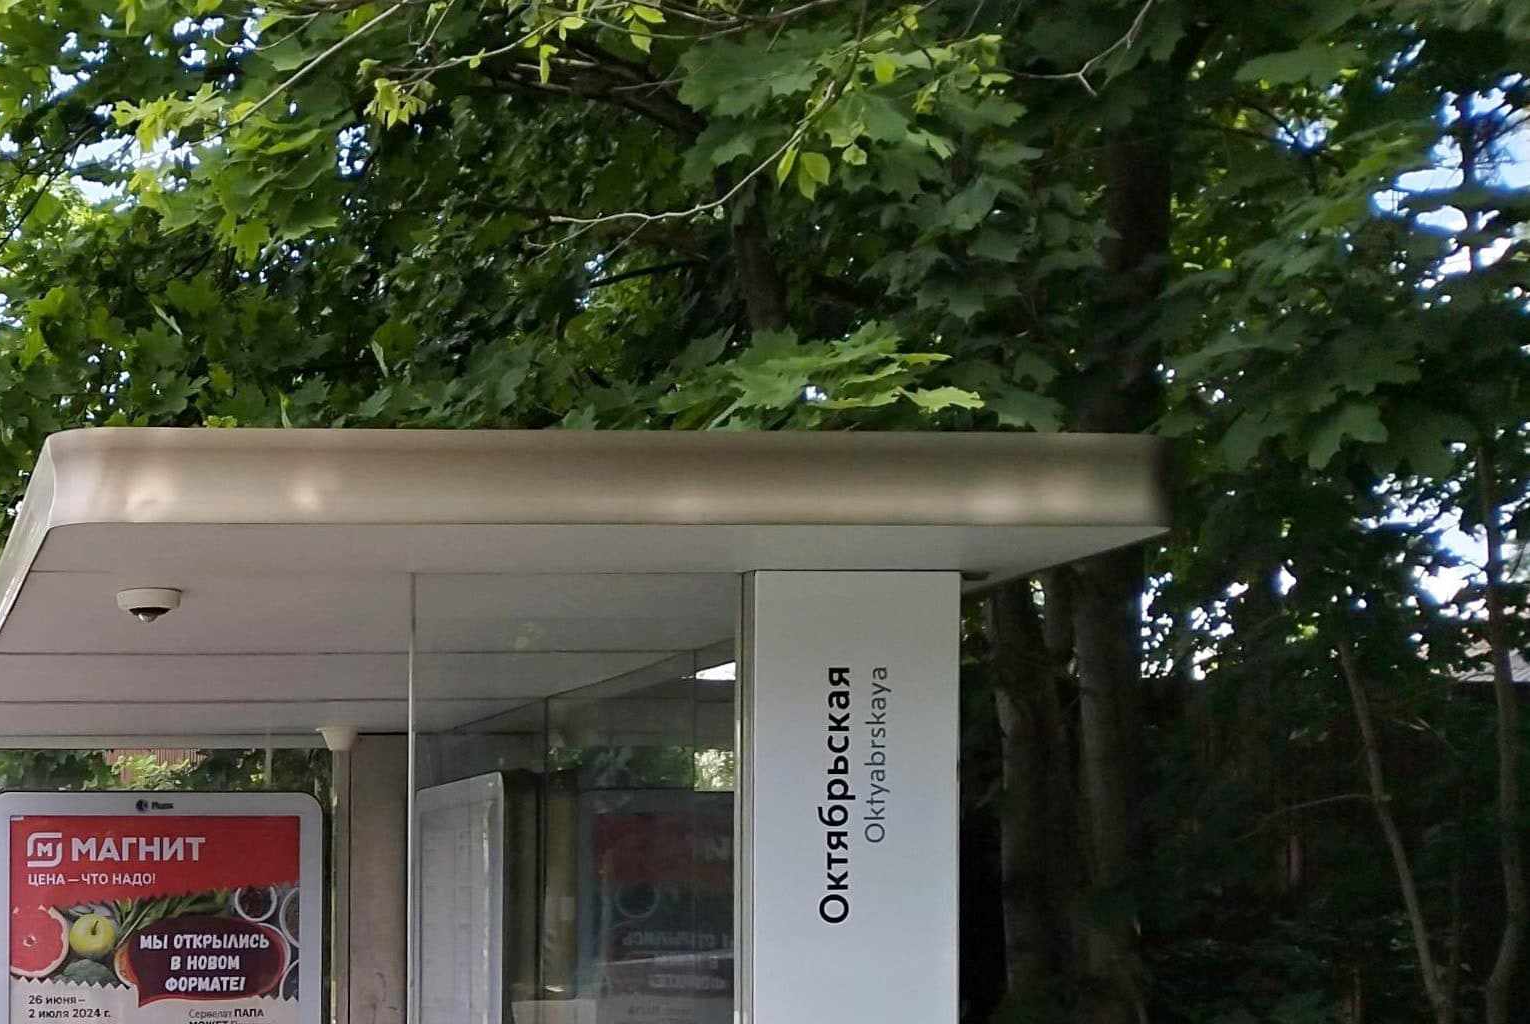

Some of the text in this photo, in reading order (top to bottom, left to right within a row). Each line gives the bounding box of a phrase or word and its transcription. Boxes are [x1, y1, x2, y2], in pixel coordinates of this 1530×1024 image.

[863, 666, 892, 843] Oktyabrskaya
[817, 666, 856, 924] Октябрьская
[71, 837, 206, 862] МАГНИТ
[28, 873, 66, 887] ЦЕНА
[81, 873, 109, 886] ЧТО
[112, 873, 156, 887] НАДО!
[140, 933, 270, 950] МЫ ОТКРЫЛИСЬ
[170, 954, 240, 971] В НОВОМ
[165, 975, 246, 992] ФОРМАТЕ!
[28, 994, 43, 1005] 26
[28, 1008, 35, 1018] 2
[38, 1009, 70, 1019] июля
[72, 1007, 101, 1018] 2024
[234, 1008, 264, 1017] ПАПА
